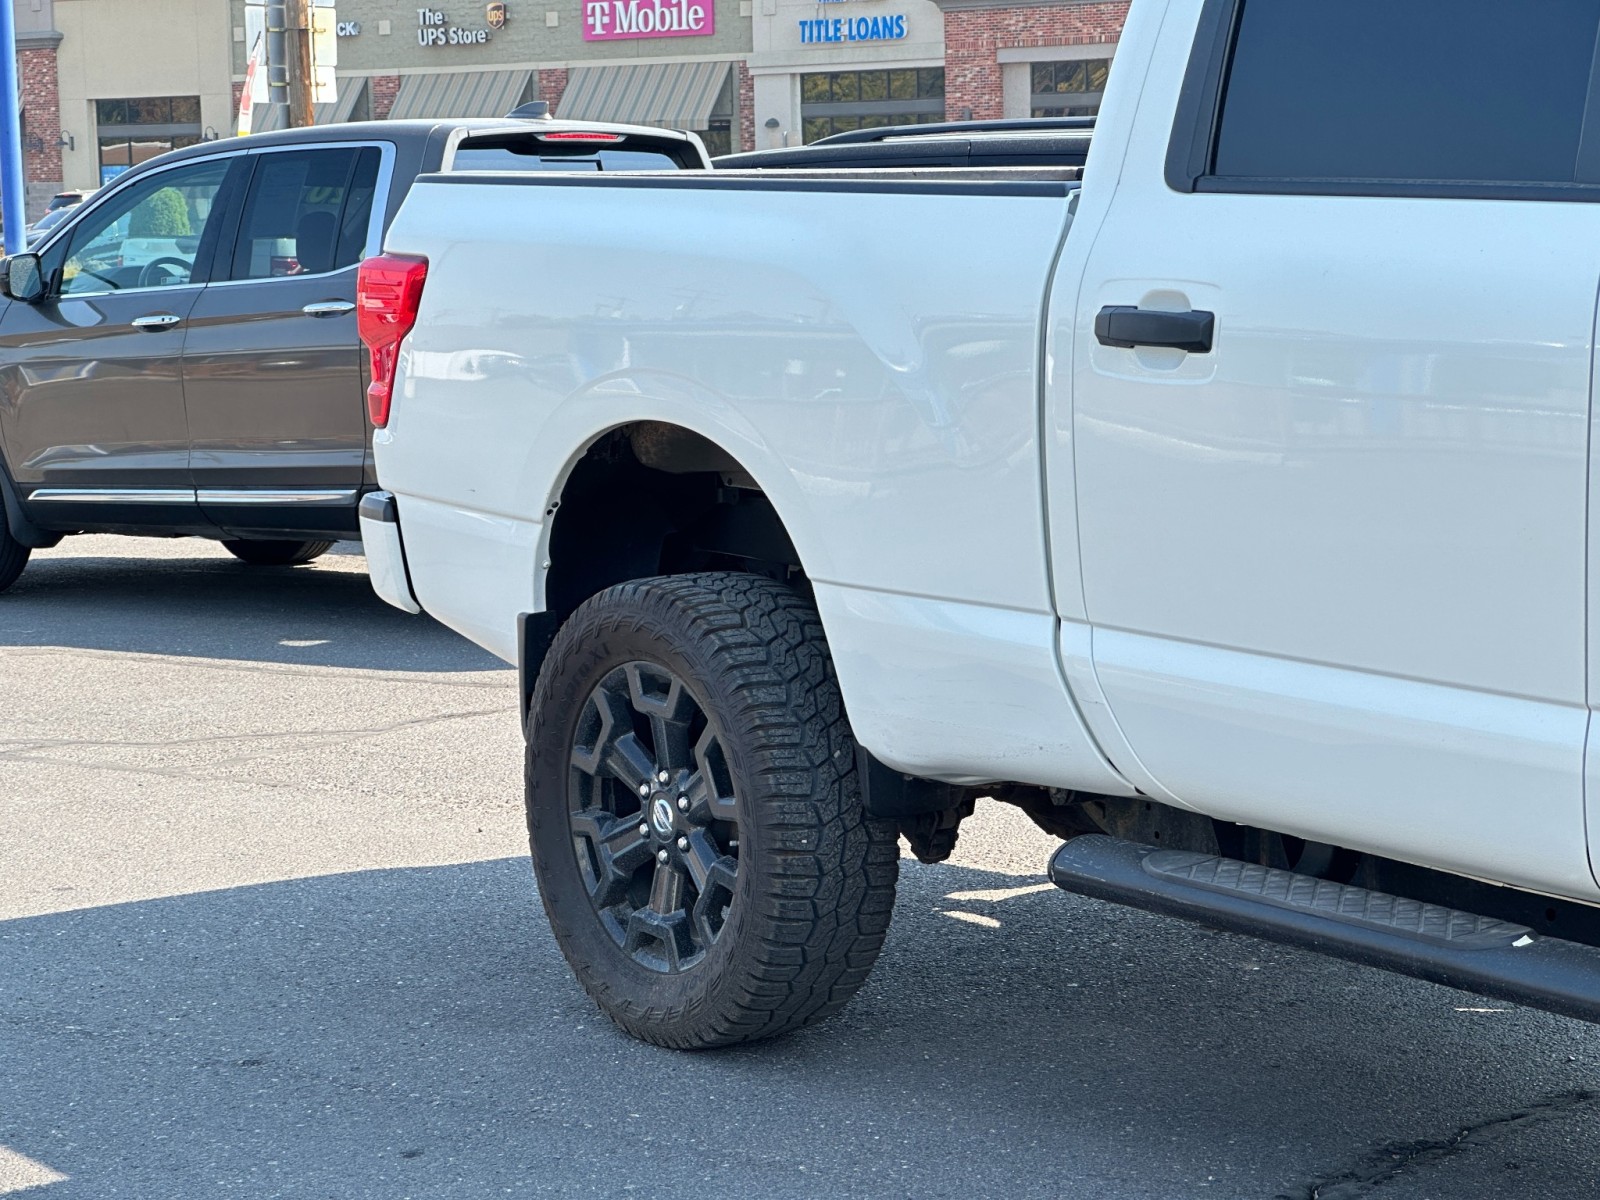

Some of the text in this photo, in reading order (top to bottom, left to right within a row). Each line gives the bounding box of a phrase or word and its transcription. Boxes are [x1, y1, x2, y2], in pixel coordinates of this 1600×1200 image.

[417, 8, 443, 25] The
[488, 10, 503, 25] ups
[417, 27, 487, 46] UPS Store
[799, 15, 905, 43] TITLE LOANS
